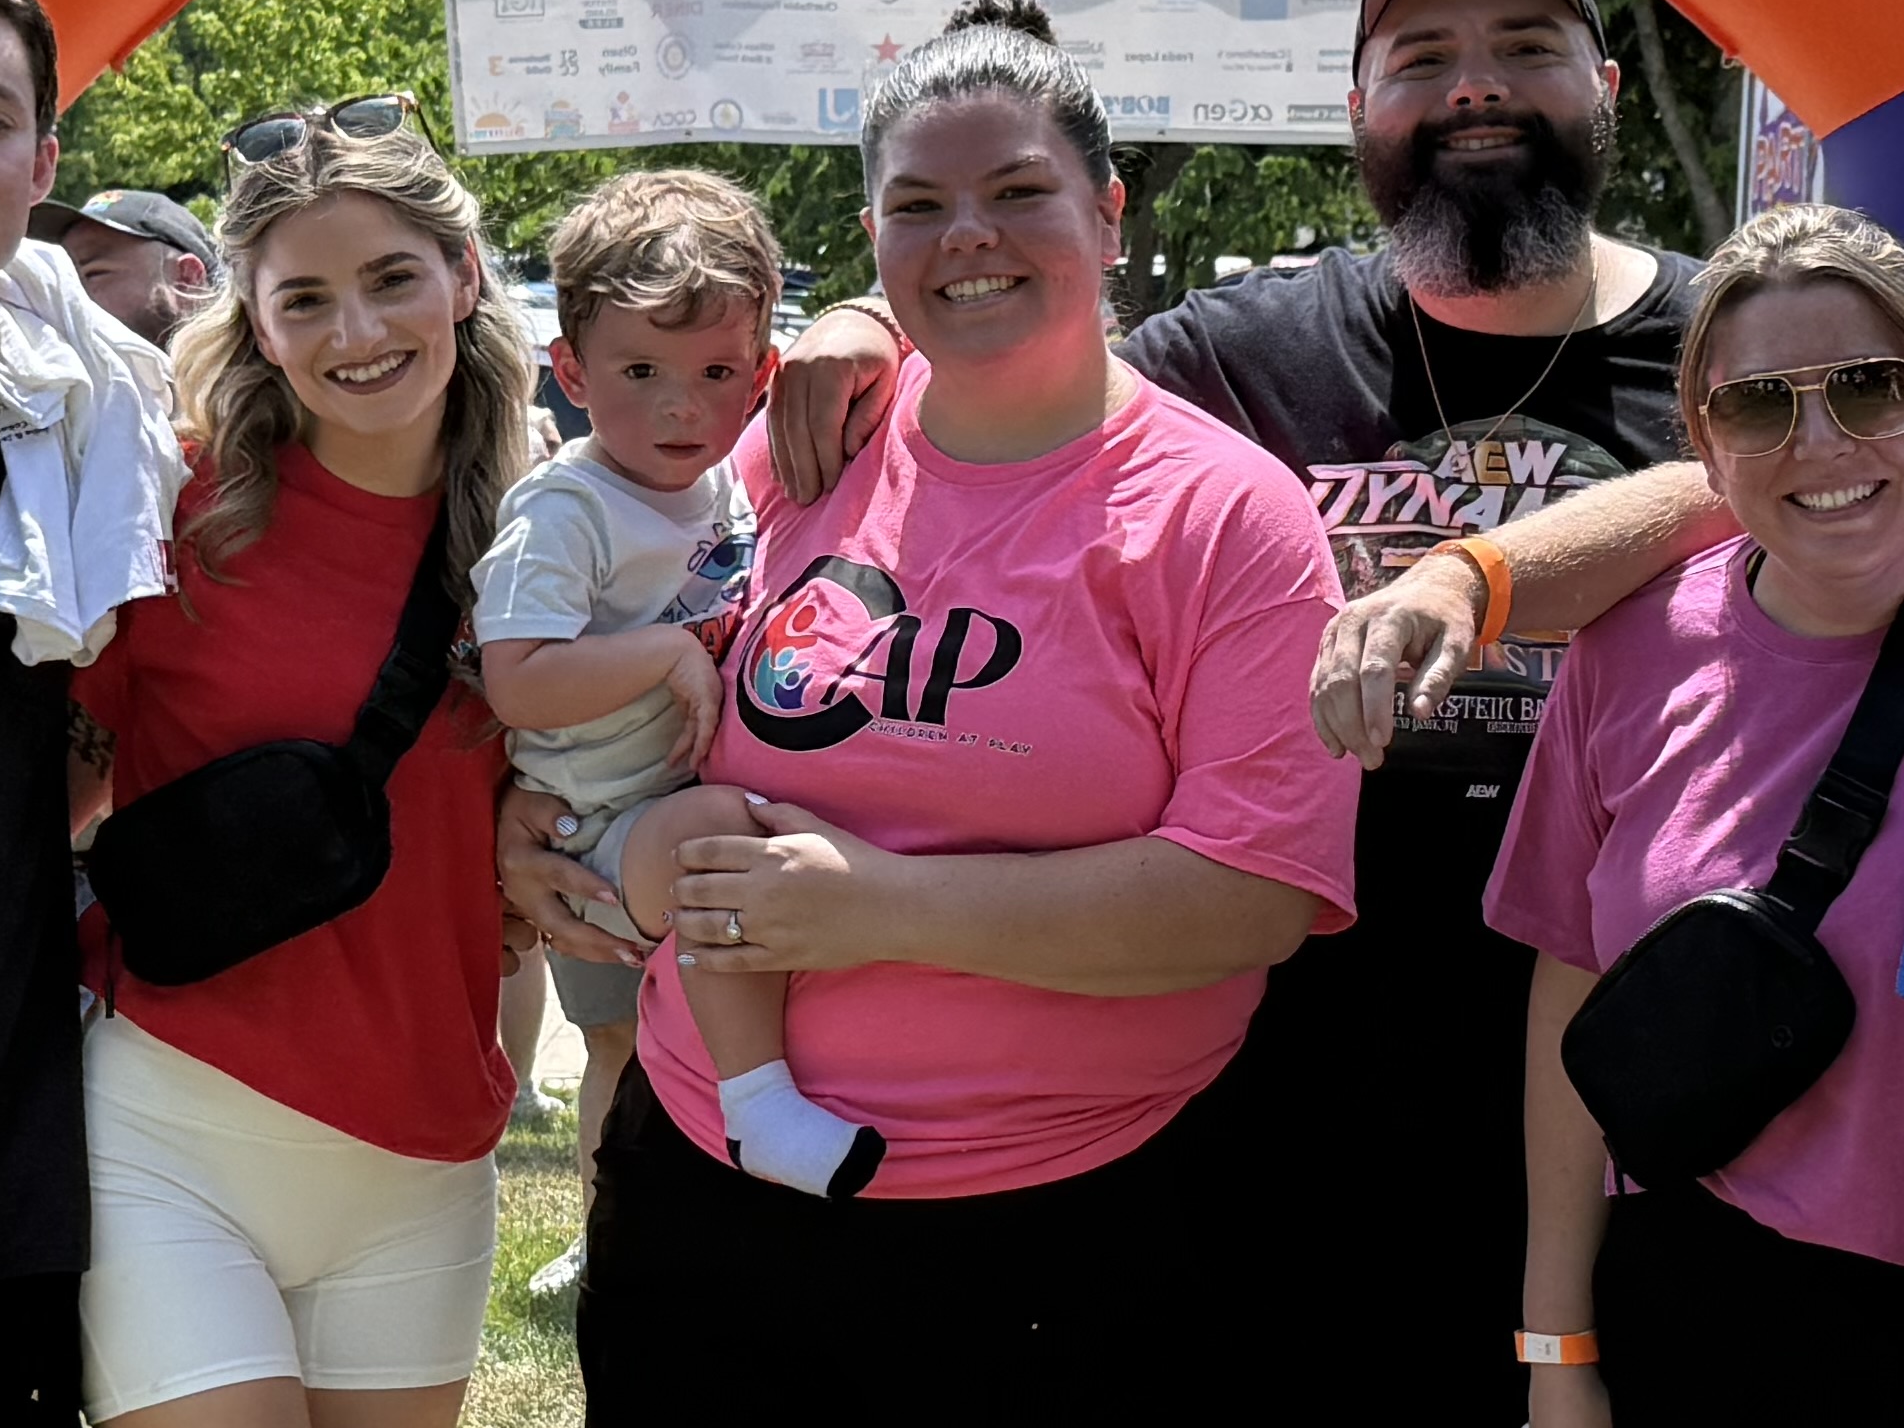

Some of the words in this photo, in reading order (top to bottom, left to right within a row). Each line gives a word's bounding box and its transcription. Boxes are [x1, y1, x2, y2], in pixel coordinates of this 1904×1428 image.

[1433, 440, 1567, 485] AEW
[1307, 460, 1546, 534] DYNA
[737, 554, 1023, 752] CAP
[957, 733, 979, 745] AT
[1465, 784, 1500, 798] AEW
